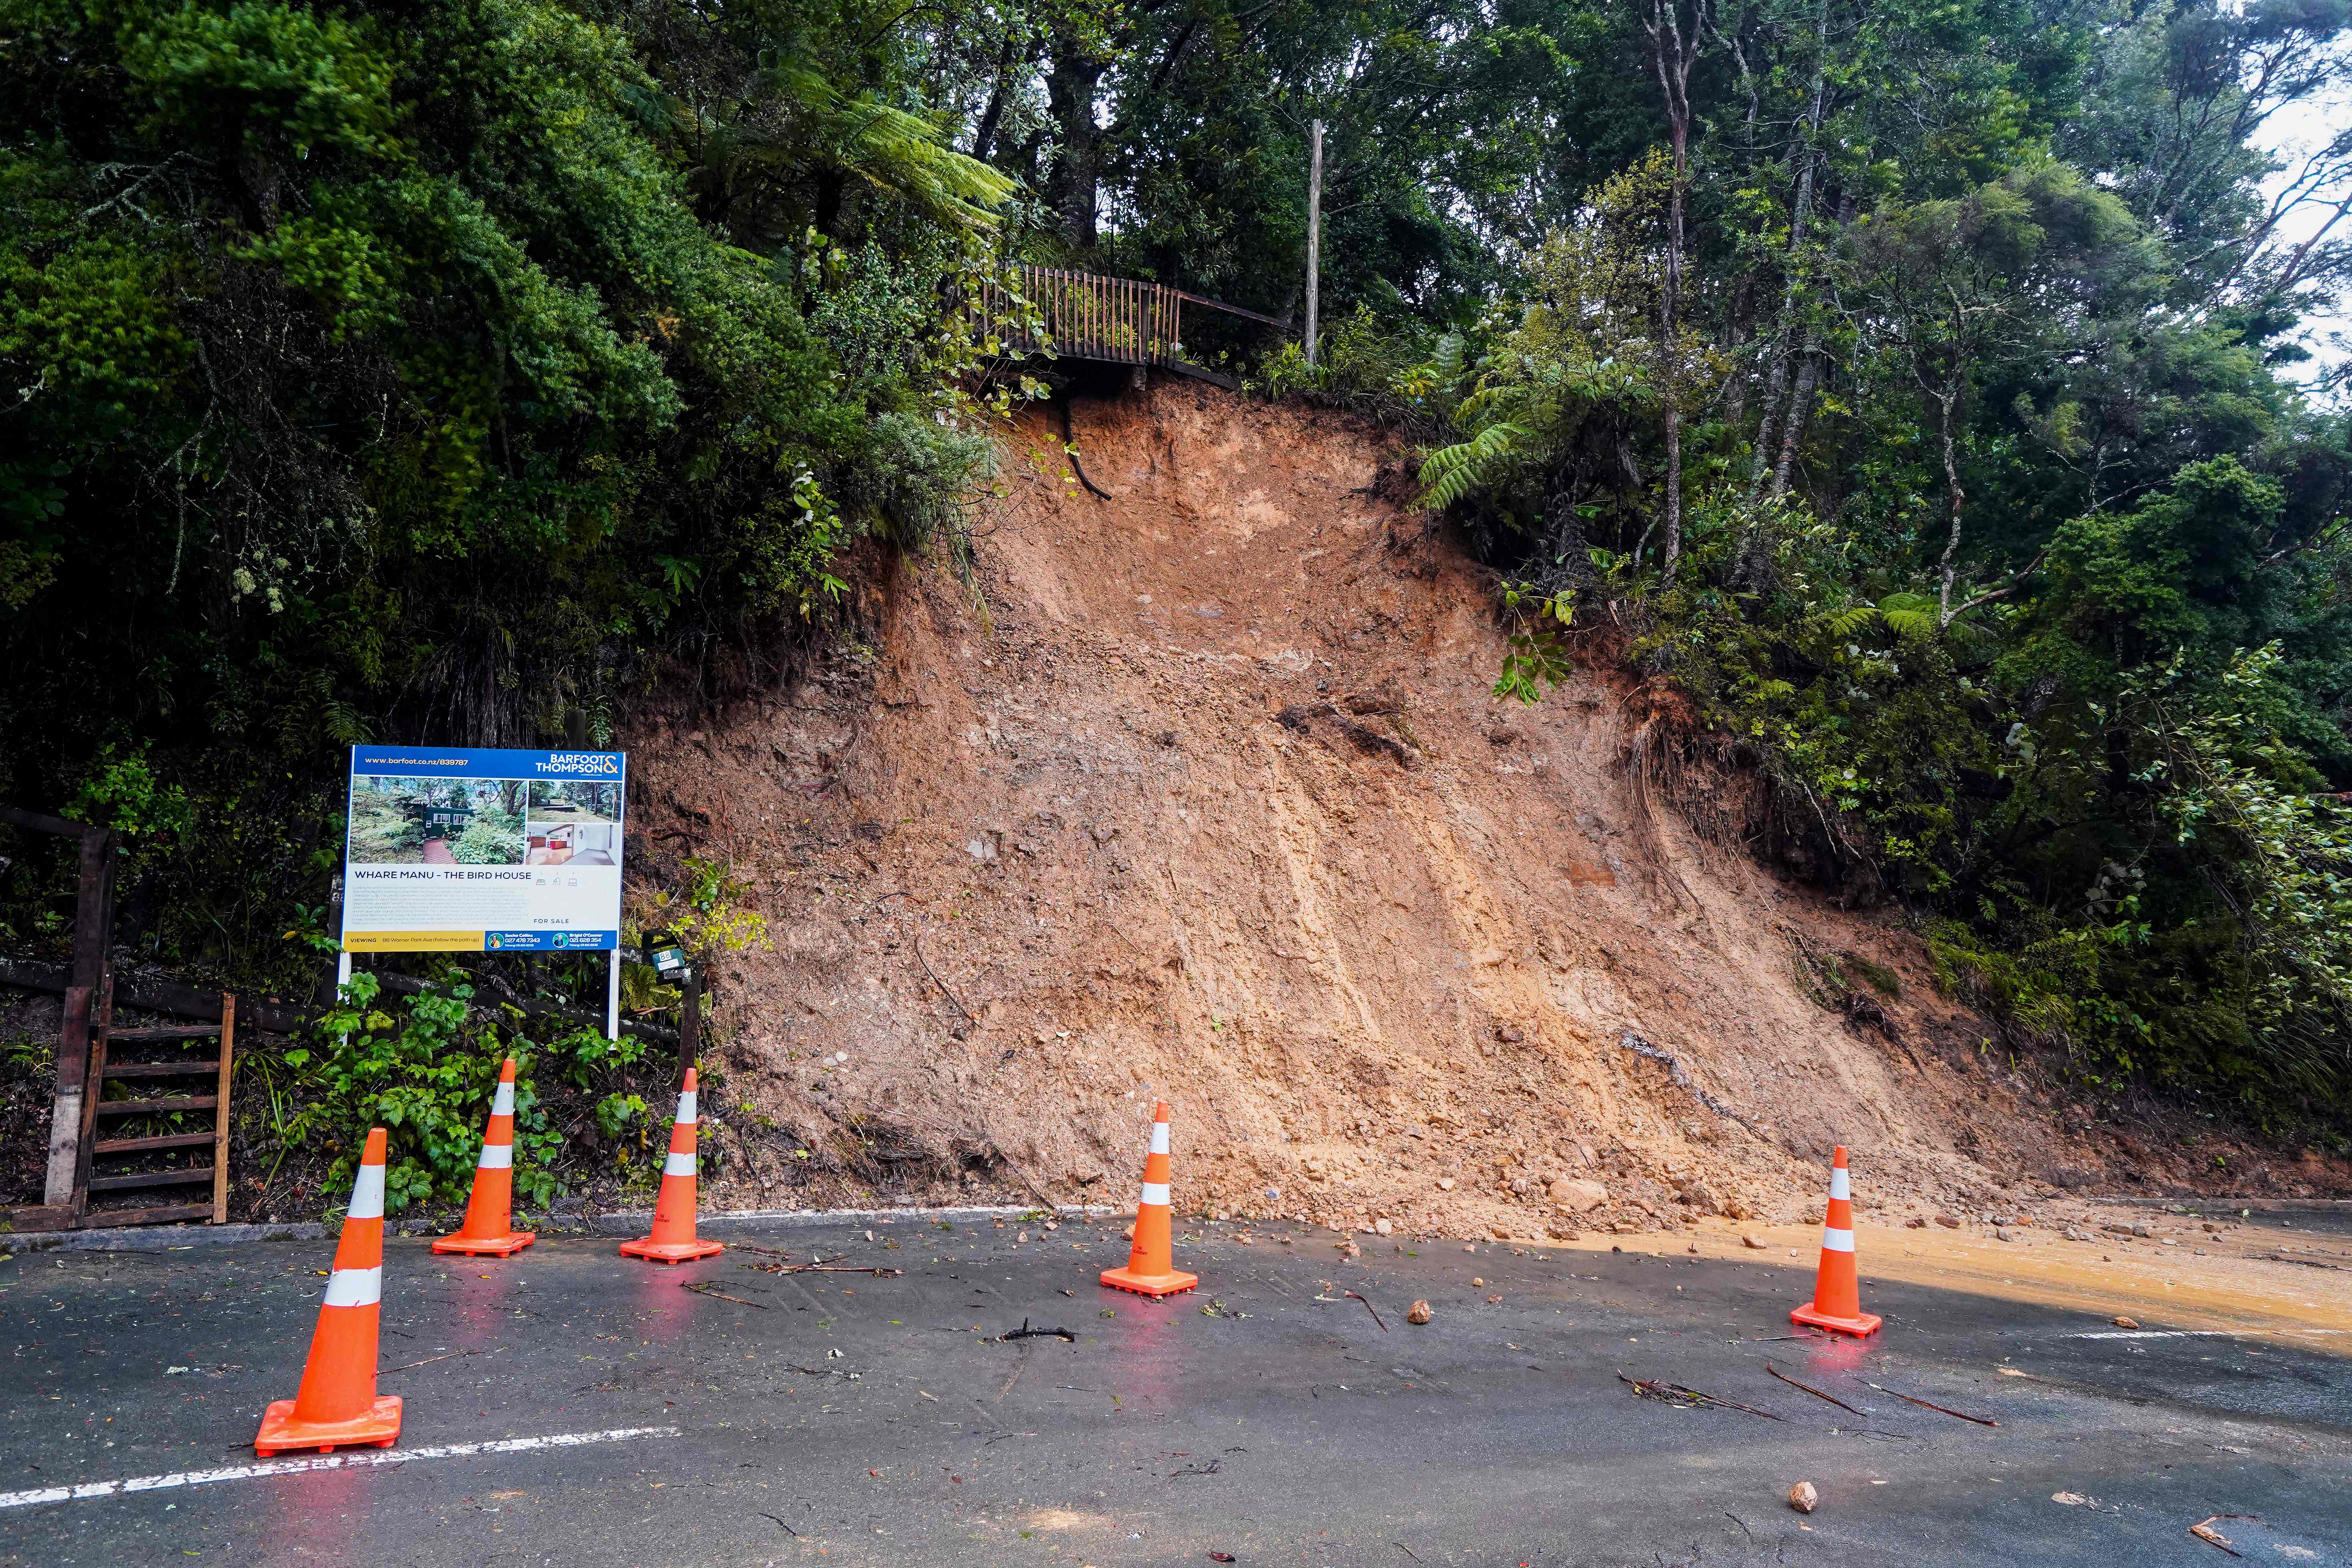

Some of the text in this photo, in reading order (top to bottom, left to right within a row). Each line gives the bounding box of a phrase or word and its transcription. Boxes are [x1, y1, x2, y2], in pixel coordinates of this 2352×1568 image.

[365, 758, 468, 766] www.barfoot.co.nz/839787
[550, 754, 618, 774] BARFOOT &
[535, 762, 602, 773] THOMPSON
[355, 871, 397, 879] WHARE
[400, 871, 434, 879] MANU
